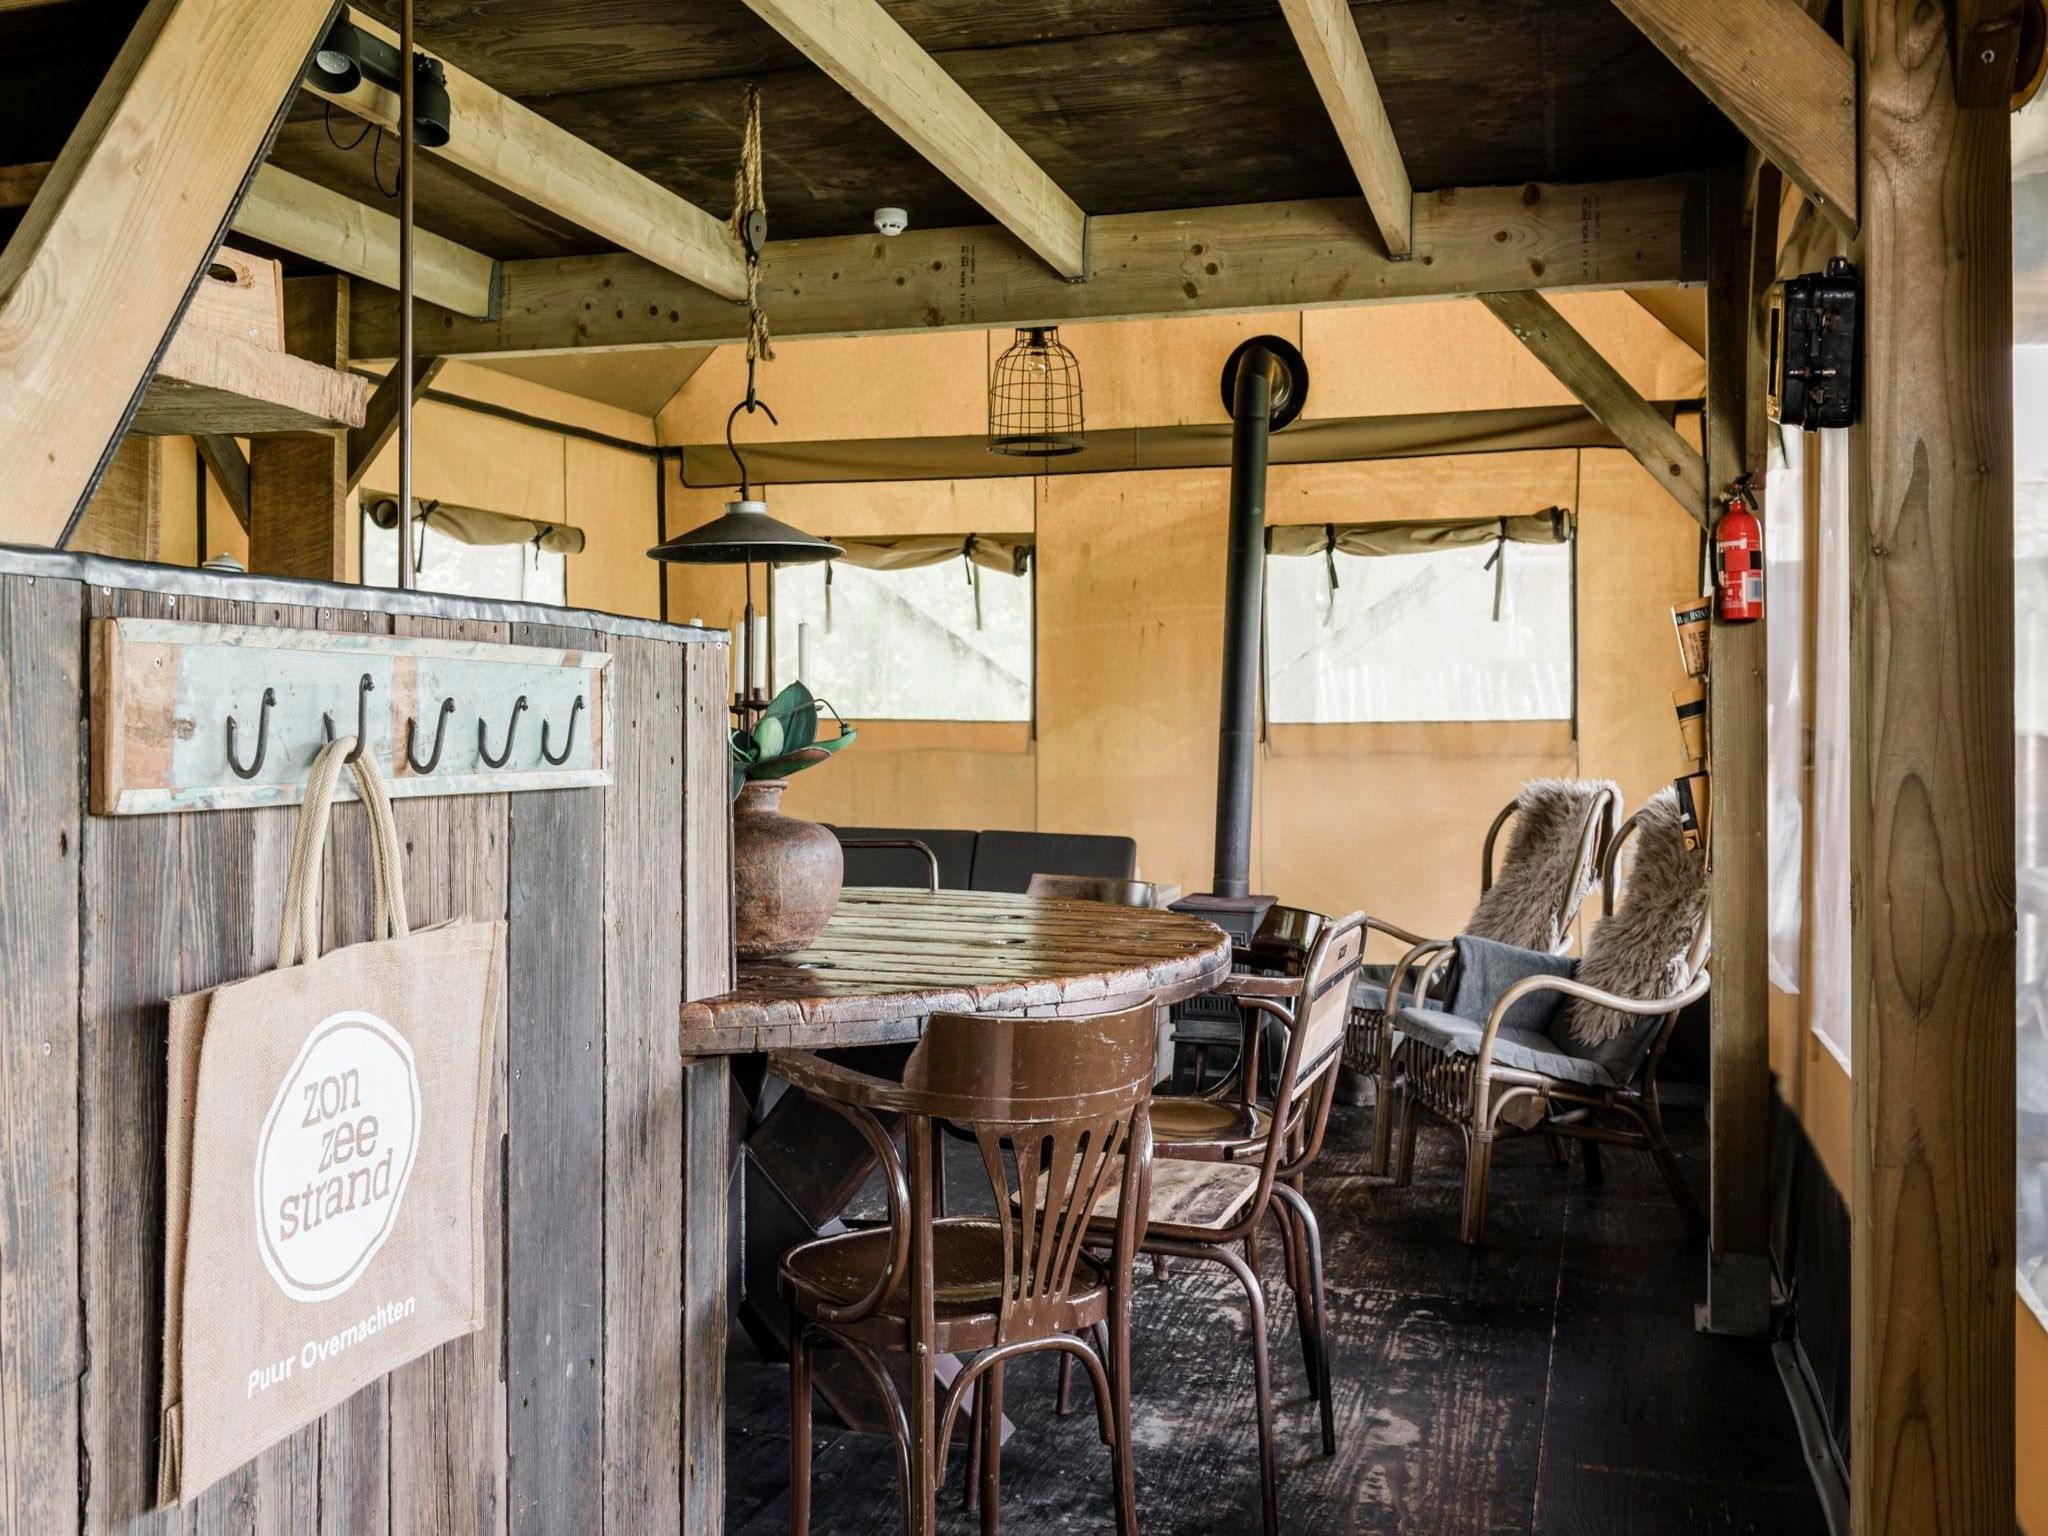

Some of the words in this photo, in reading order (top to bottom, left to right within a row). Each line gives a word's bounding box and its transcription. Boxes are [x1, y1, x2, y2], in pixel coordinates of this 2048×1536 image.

[303, 1068, 360, 1128] zon
[319, 1116, 378, 1173] zee
[281, 1149, 393, 1240] strand
[247, 1356, 295, 1399] Puur
[302, 1297, 416, 1369] Overnachten
